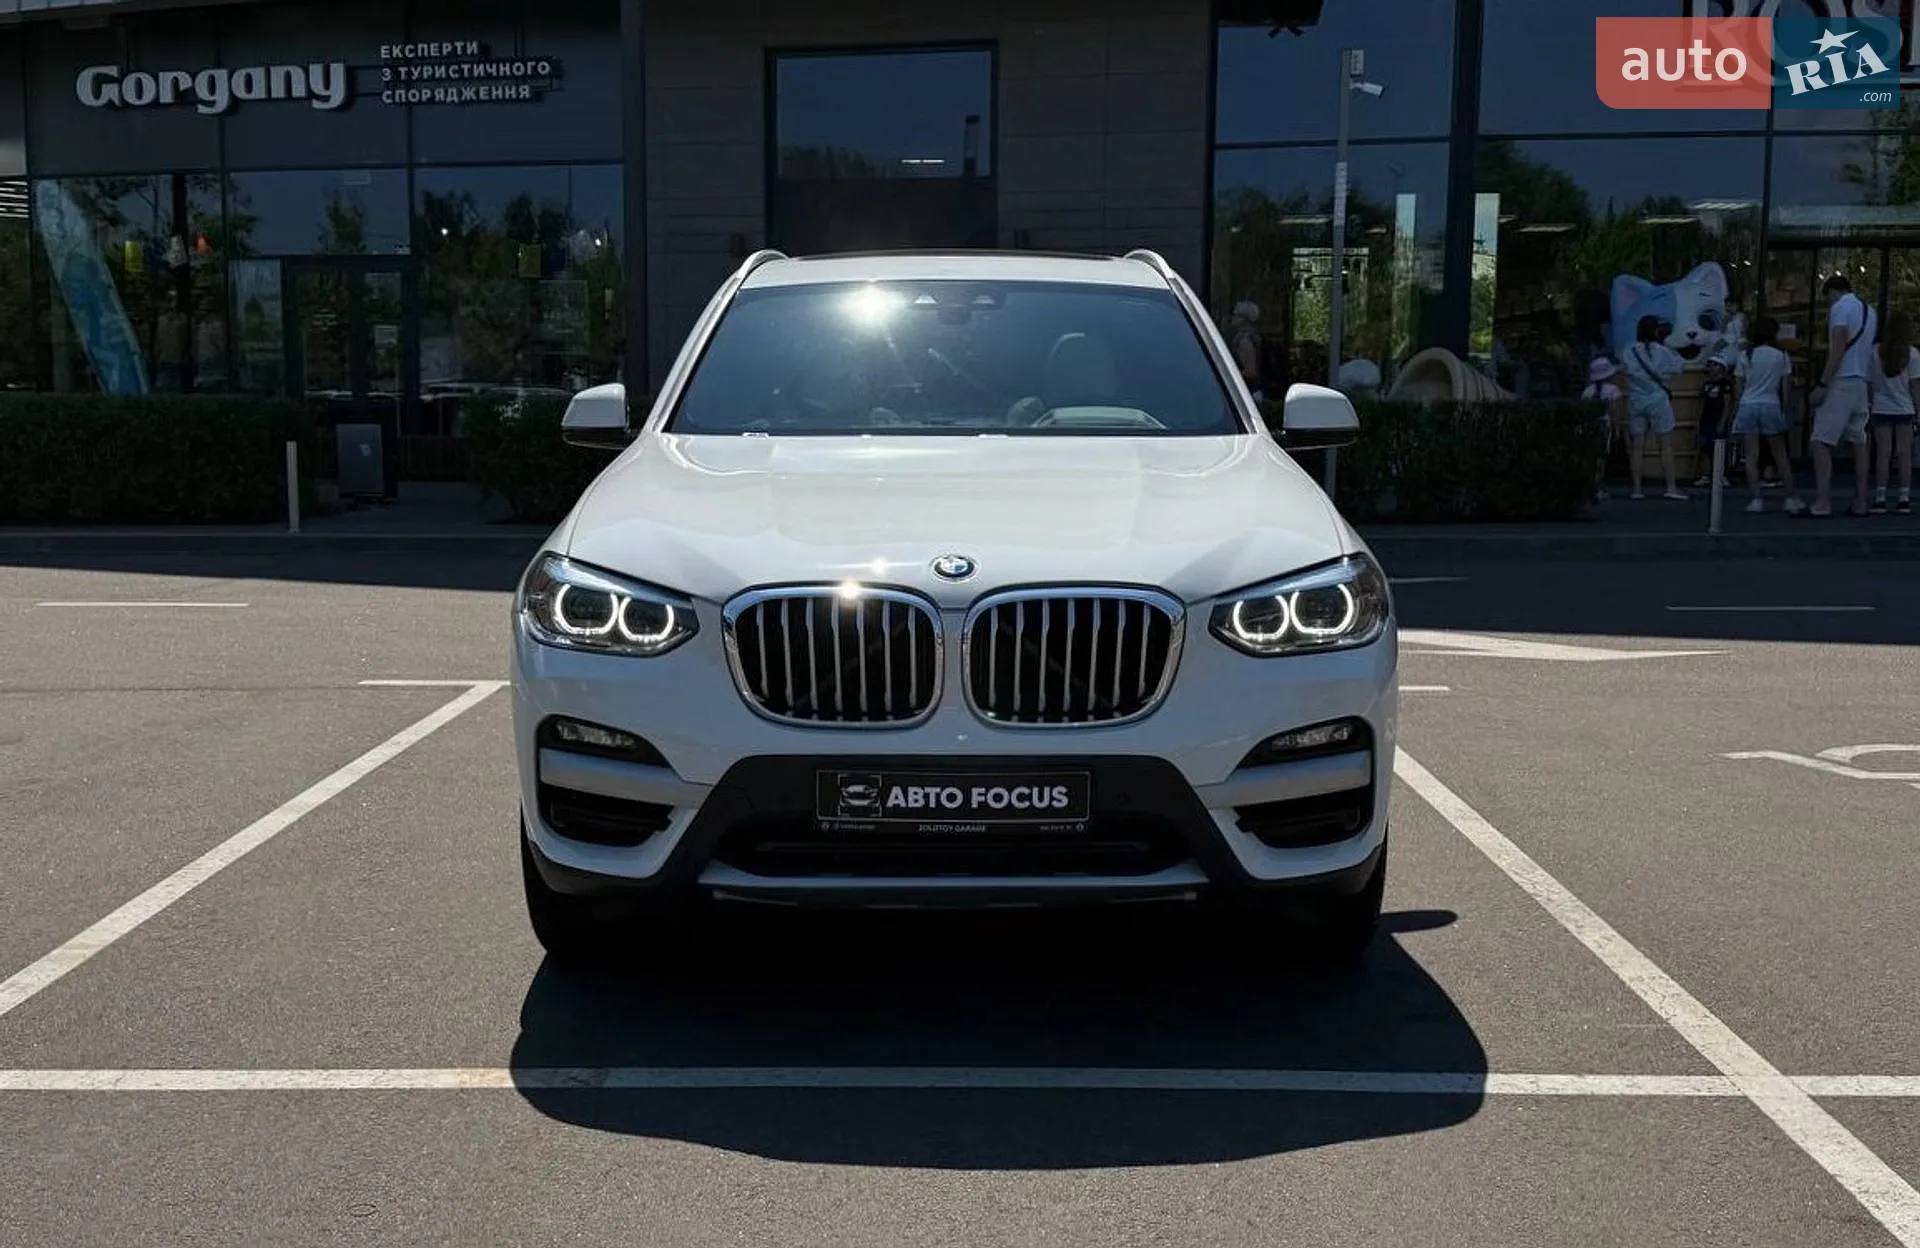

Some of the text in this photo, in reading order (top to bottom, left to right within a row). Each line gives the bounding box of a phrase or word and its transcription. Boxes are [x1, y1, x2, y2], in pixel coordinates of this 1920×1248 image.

[380, 41, 479, 59] ЕКСПЕРТИ
[398, 59, 551, 80] ТУРИСТИЧНОГО
[76, 61, 348, 115] Gorgany
[381, 84, 531, 104] СПОРЯДЖЕННЯ
[970, 785, 1069, 809] FOCUS
